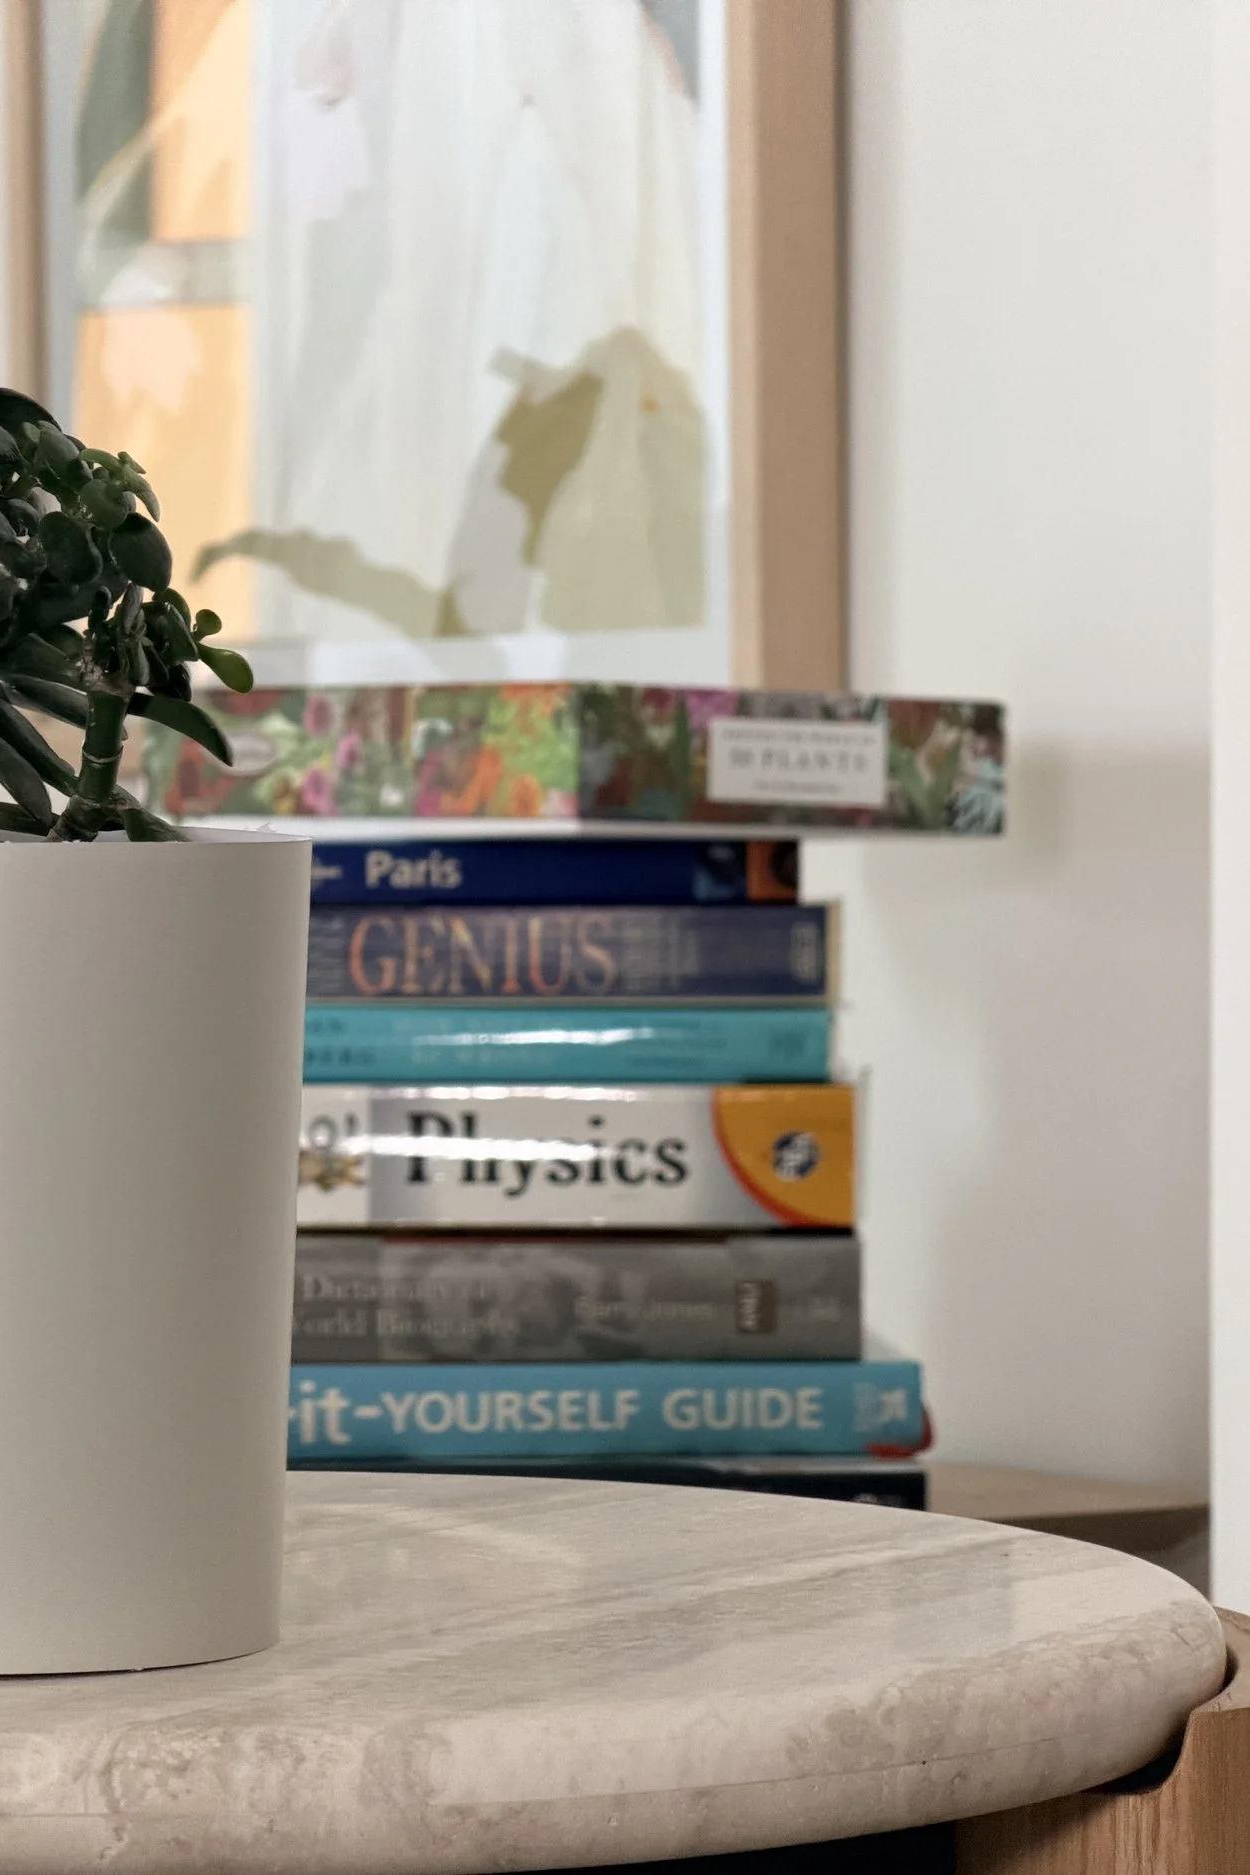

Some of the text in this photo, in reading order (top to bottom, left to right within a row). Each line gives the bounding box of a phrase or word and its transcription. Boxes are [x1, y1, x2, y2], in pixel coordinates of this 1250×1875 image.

[364, 849, 463, 890] Paris
[347, 914, 618, 997] GENIUS
[405, 1109, 690, 1199] Physics
[661, 1386, 825, 1431] GUIDE
